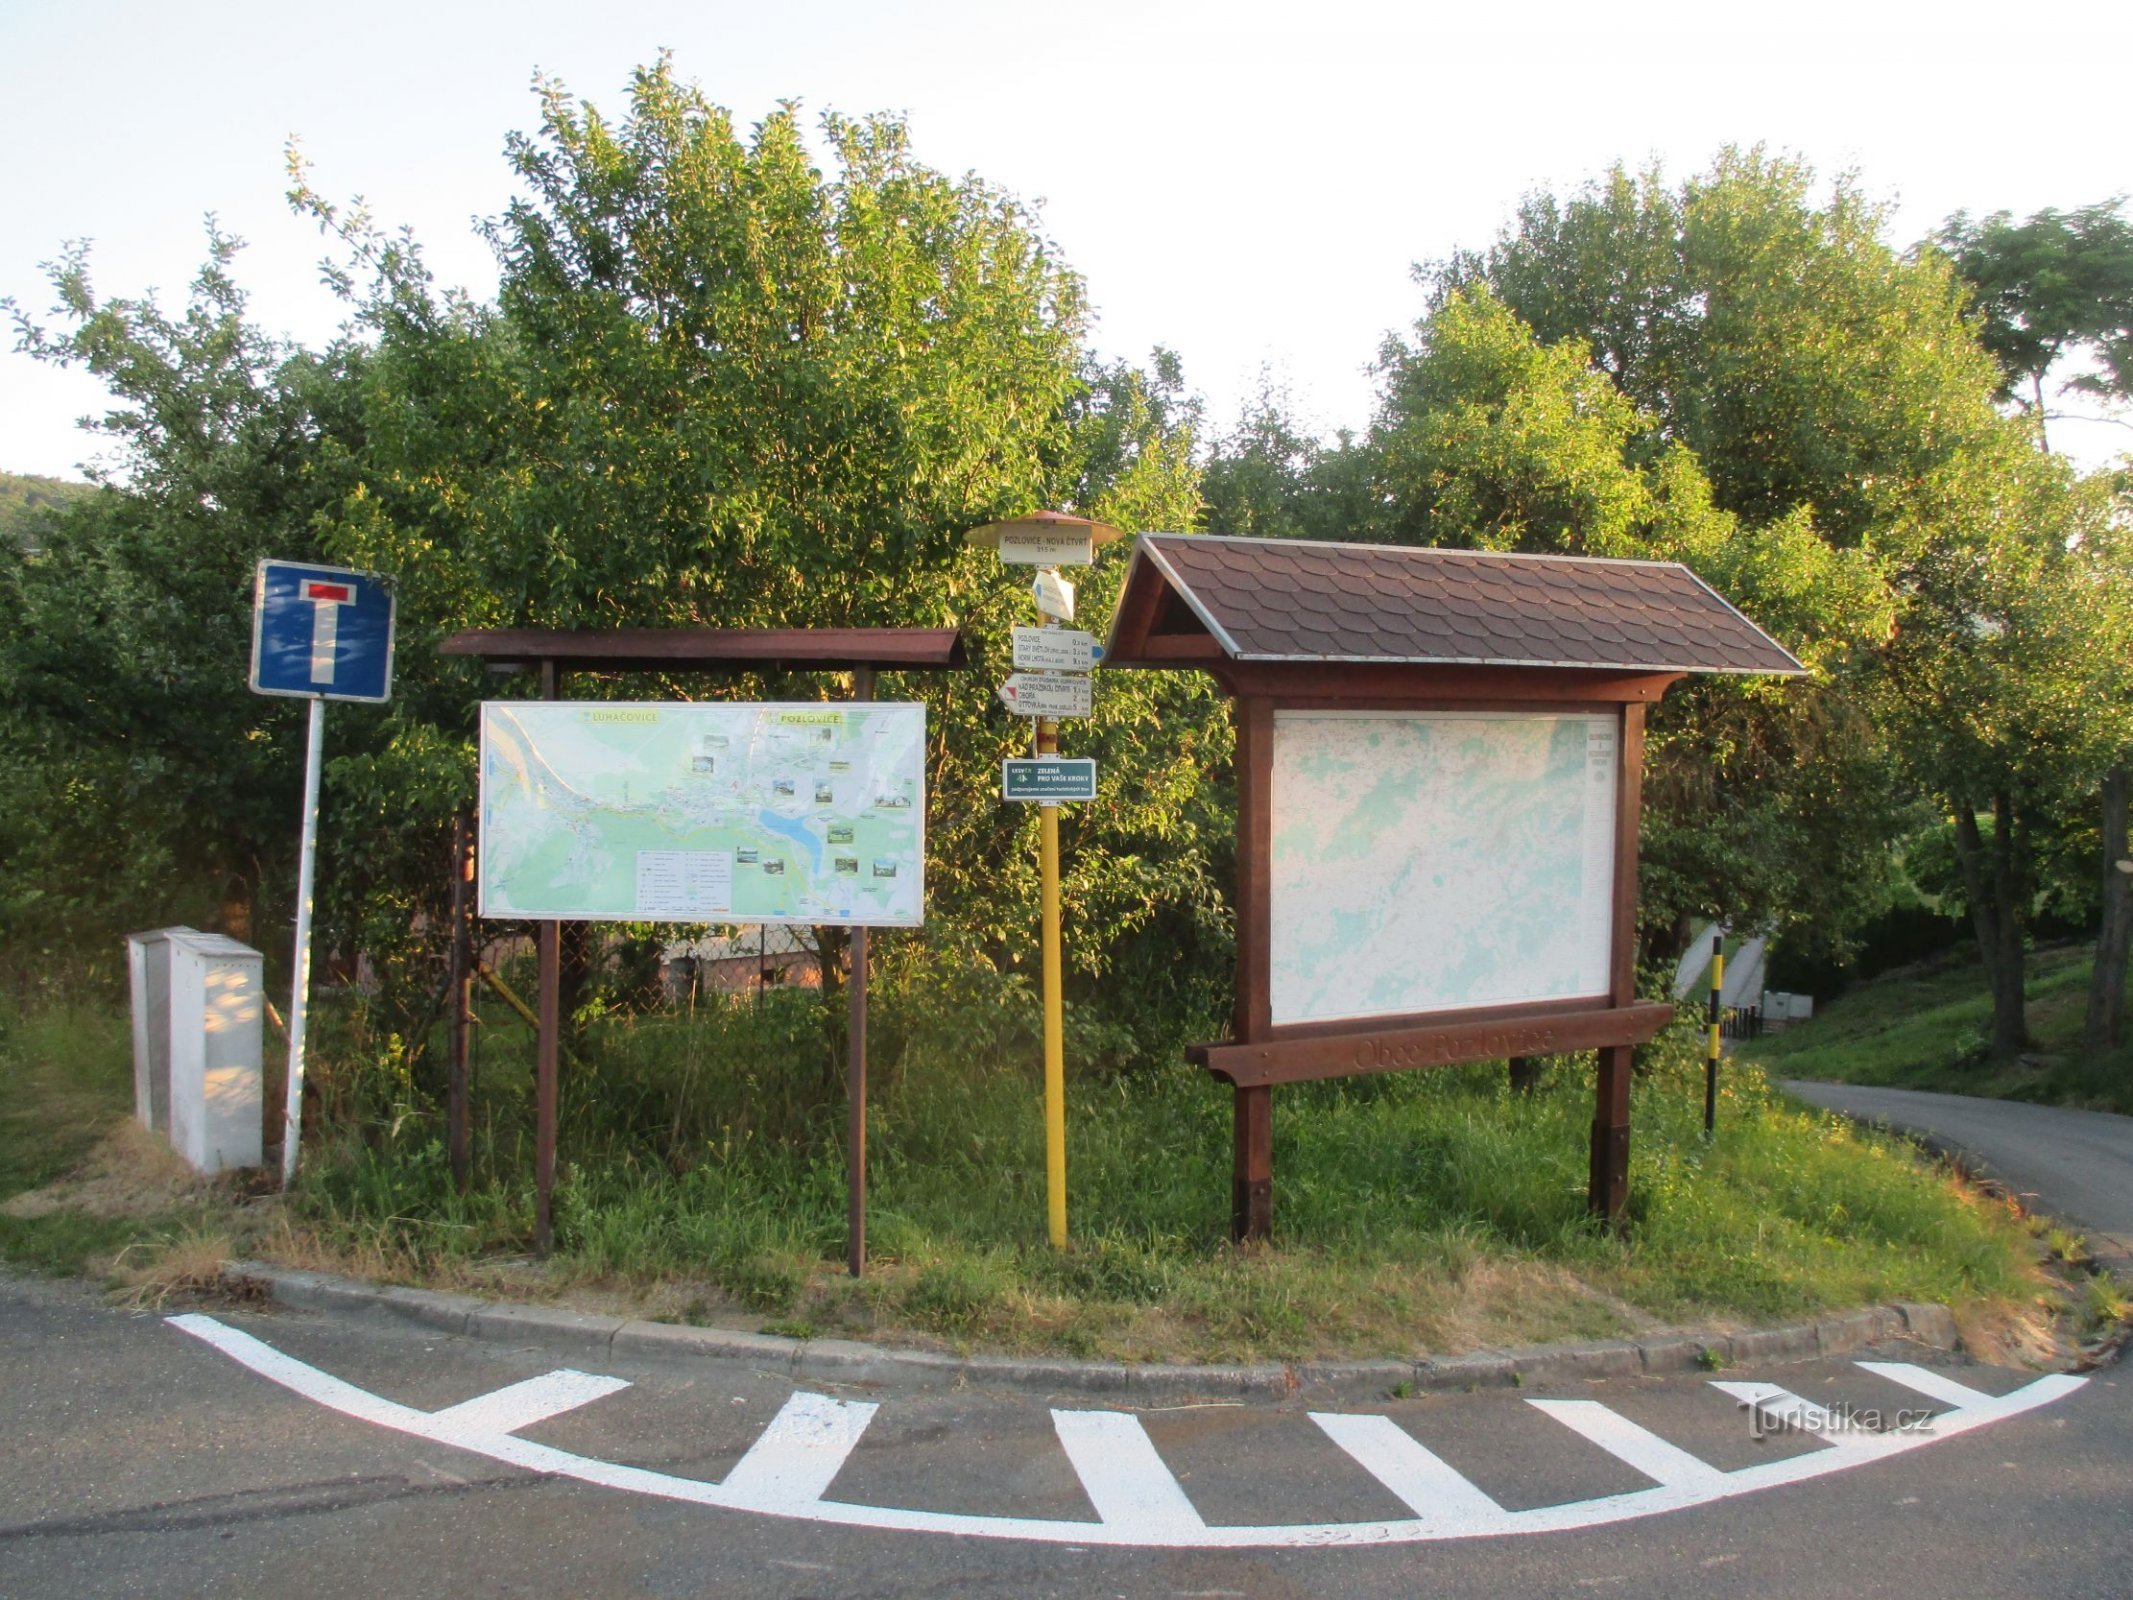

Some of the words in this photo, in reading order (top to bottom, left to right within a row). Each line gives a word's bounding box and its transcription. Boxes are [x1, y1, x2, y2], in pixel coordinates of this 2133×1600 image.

[1004, 536, 1041, 545] POZLOVICE
[592, 711, 657, 722] LUHAČOVICE
[781, 714, 840, 724] POZLOVICE
[1037, 766, 1060, 775] ZELENÁ
[1051, 774, 1066, 782] VAŠE
[1353, 1038, 1420, 1070] Obec
[1431, 1028, 1556, 1061] Pozlovice
